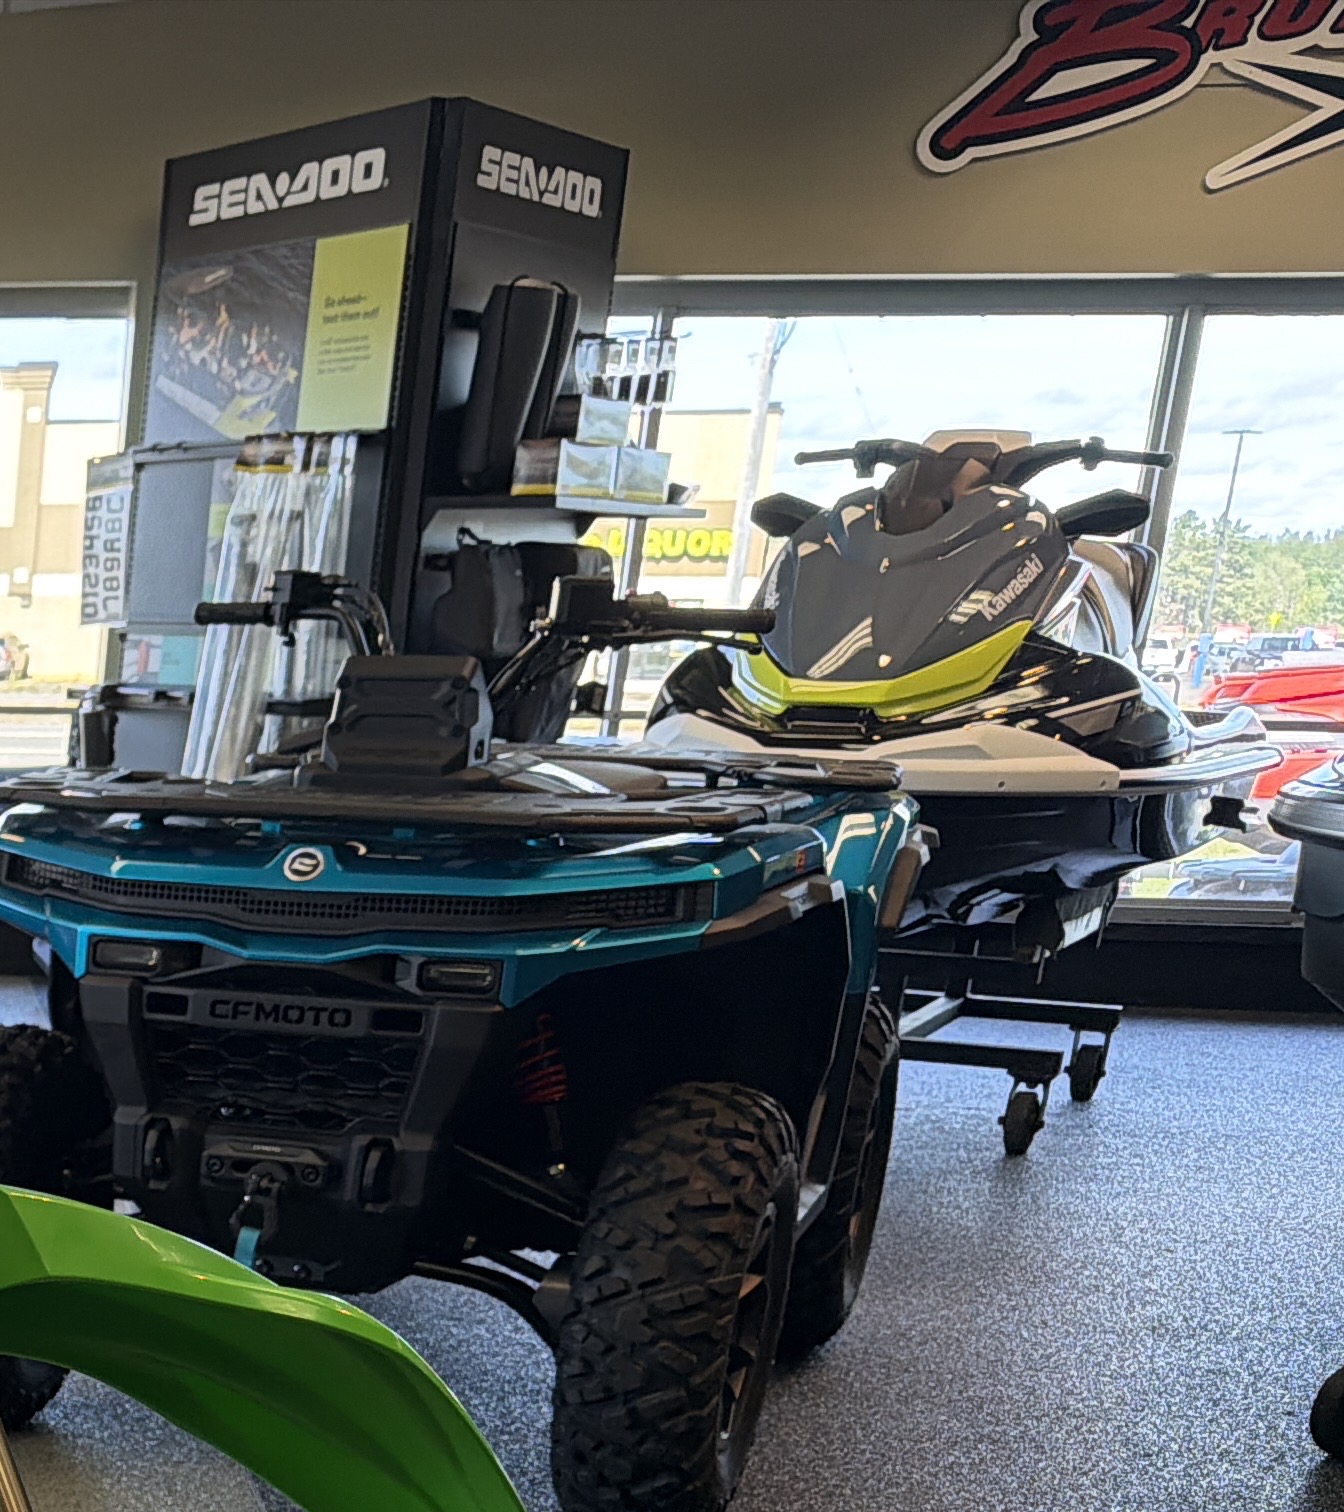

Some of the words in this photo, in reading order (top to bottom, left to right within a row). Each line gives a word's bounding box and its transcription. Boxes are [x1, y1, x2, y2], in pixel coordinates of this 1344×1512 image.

[930, 0, 1344, 160] BRU
[608, 528, 732, 558] LQUOR
[980, 552, 1044, 622] Kawasaki
[209, 1000, 353, 1029] CFMOTO
